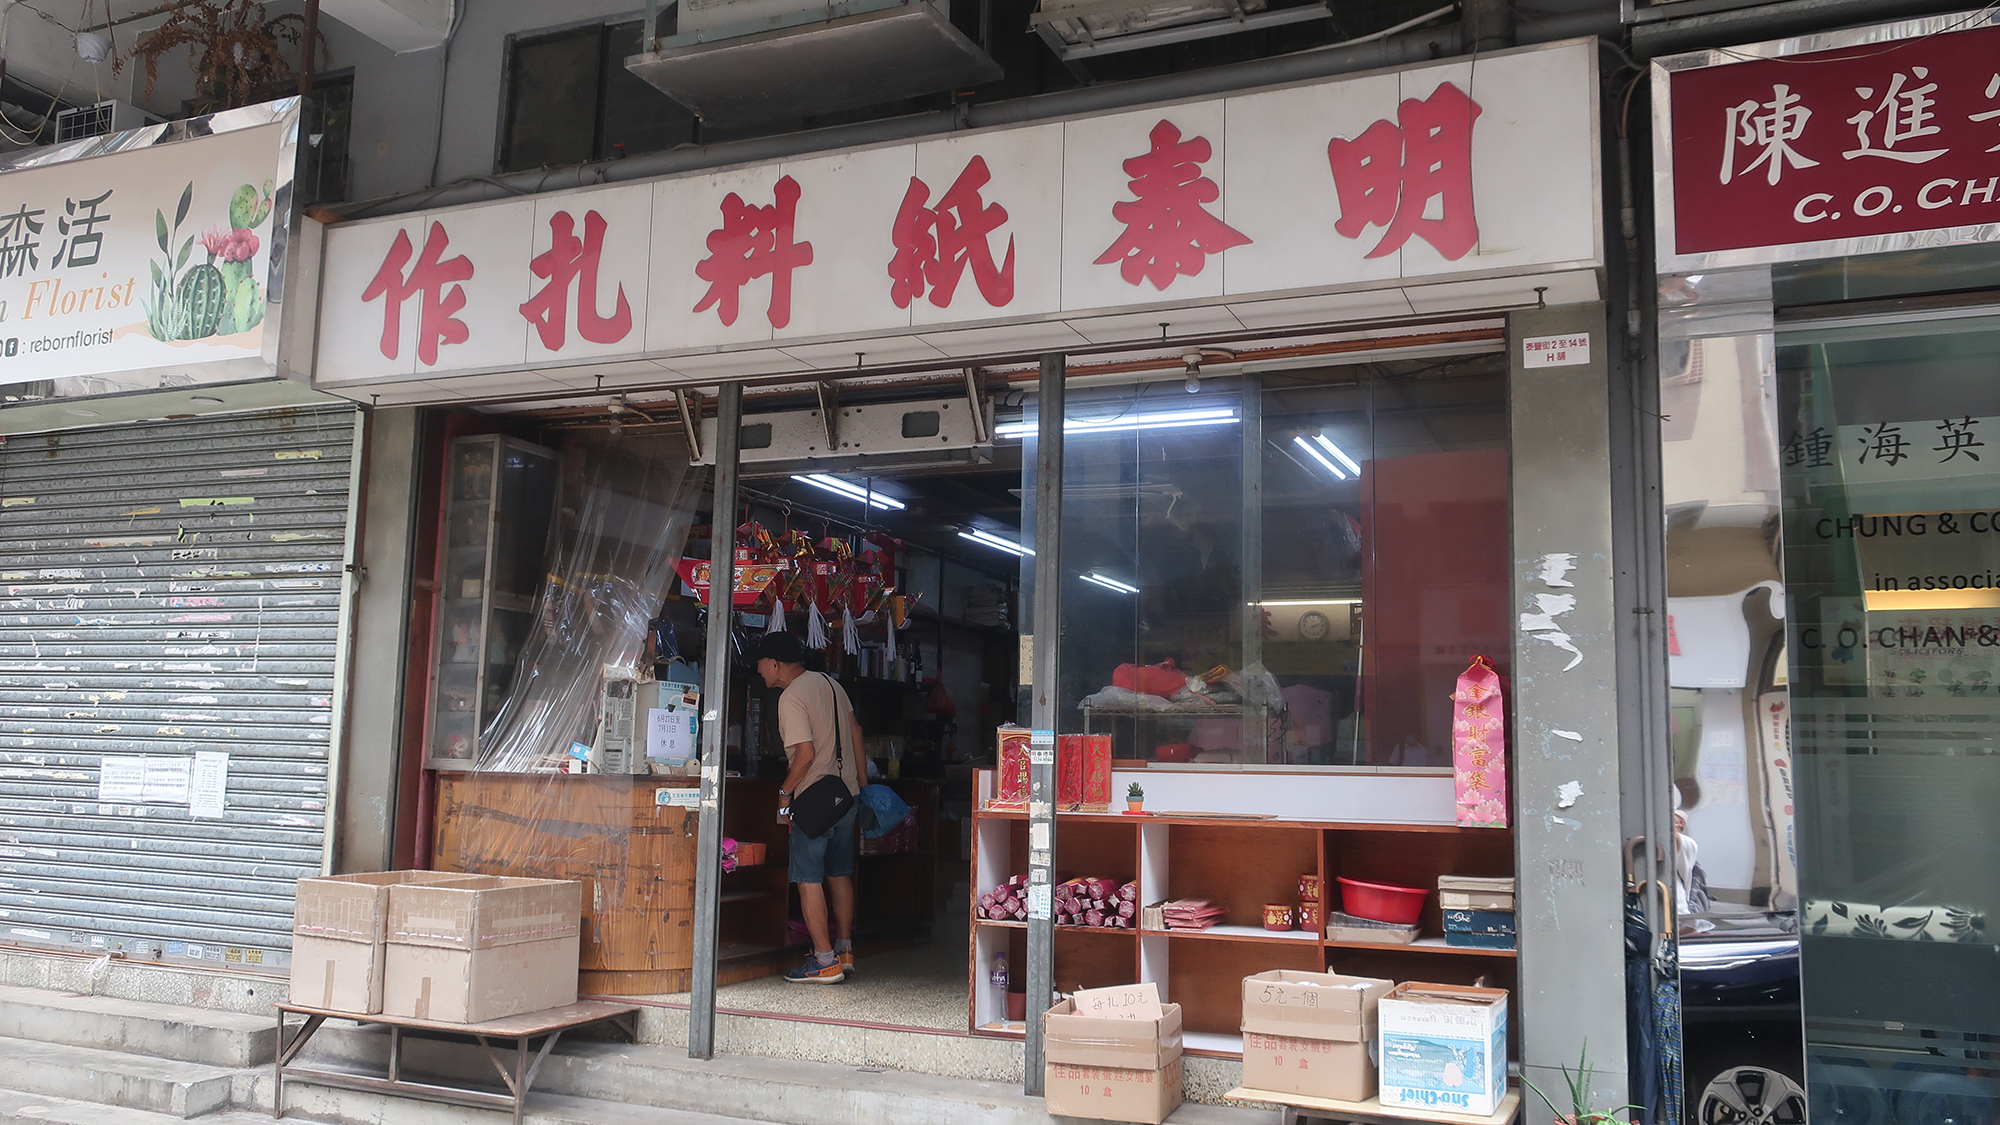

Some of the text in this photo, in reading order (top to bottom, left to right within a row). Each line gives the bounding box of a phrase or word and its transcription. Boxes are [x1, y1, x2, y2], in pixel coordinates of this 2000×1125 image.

[1915, 176, 2000, 210] CH
[20, 272, 136, 320] Florist
[29, 327, 113, 353] rebornflorist
[1816, 515, 1926, 539] CHUNG
[1937, 512, 1960, 534] &
[1875, 573, 1899, 591] in
[1878, 625, 1966, 649] CHAN
[1464, 683, 1491, 791] 金銀財富袋
[1091, 743, 1104, 797] 天官賜福
[1274, 1055, 1283, 1066] 10
[1080, 1084, 1090, 1095] 10
